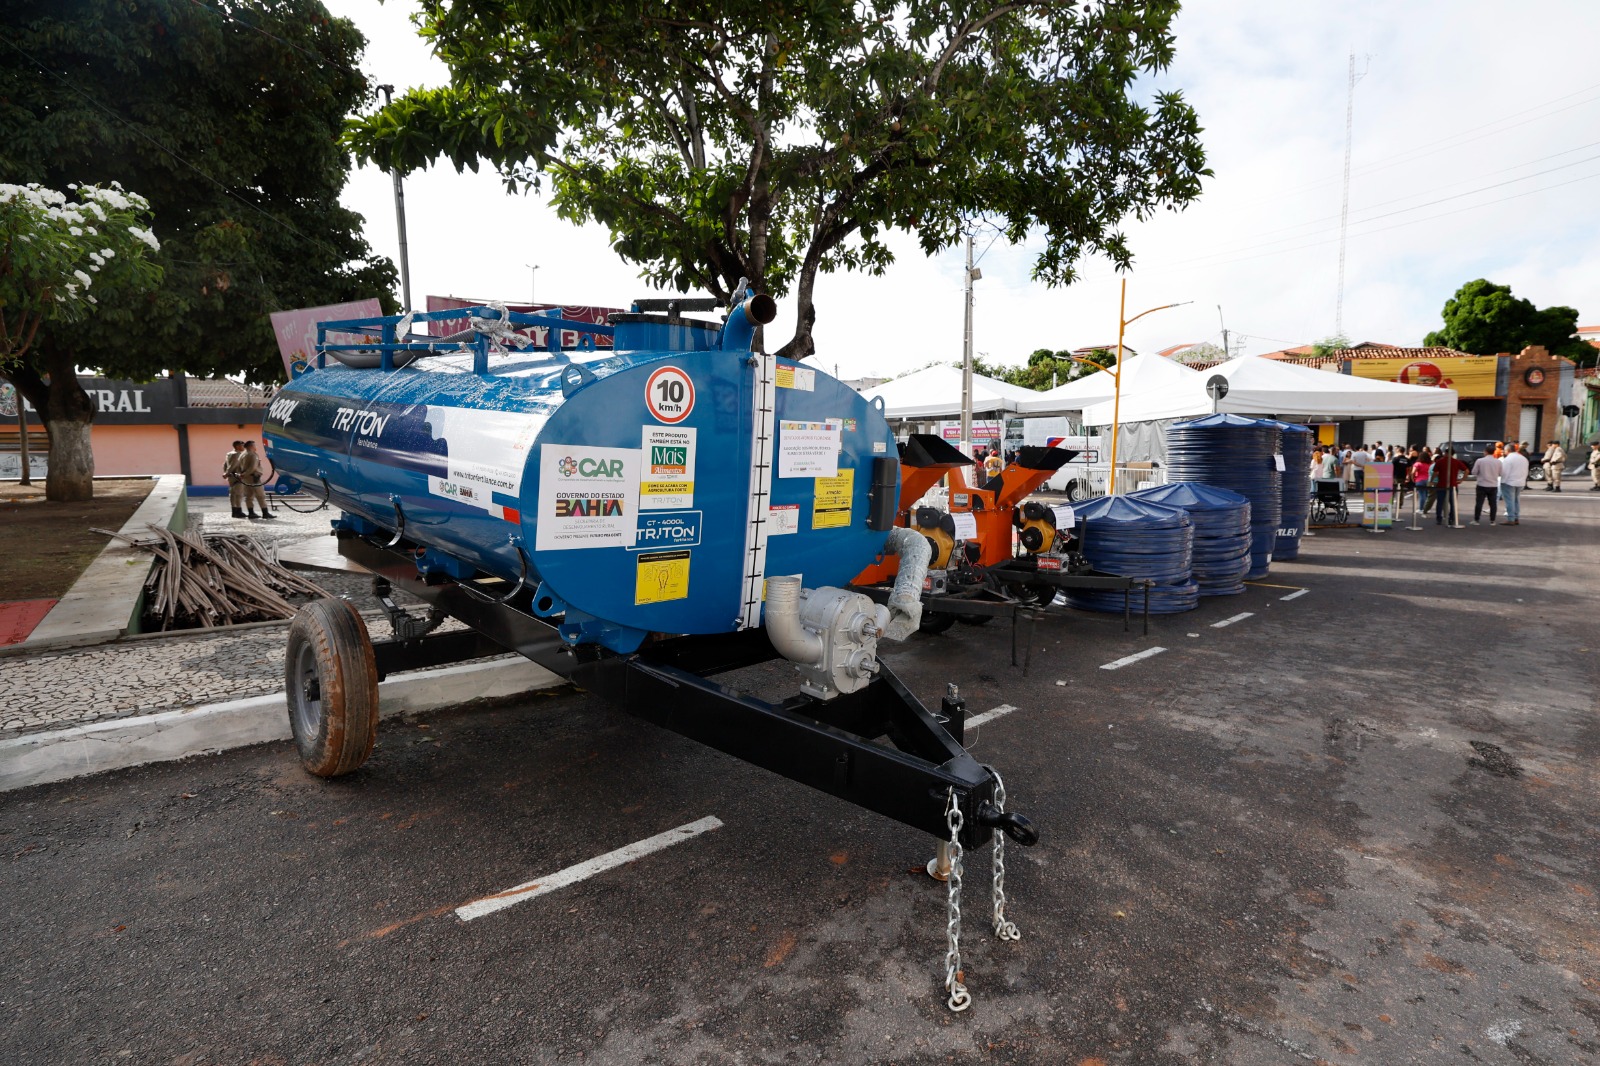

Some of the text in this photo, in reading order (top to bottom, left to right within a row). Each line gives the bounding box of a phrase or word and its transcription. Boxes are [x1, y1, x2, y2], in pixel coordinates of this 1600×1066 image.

[656, 379, 684, 403] 10
[658, 402, 682, 412] km/h
[331, 407, 391, 438] TRITON
[653, 447, 684, 465] Mais
[578, 457, 624, 478] CAR
[444, 481, 458, 496] CAR
[555, 499, 624, 517] BAHIA
[636, 526, 695, 540] TRITON
